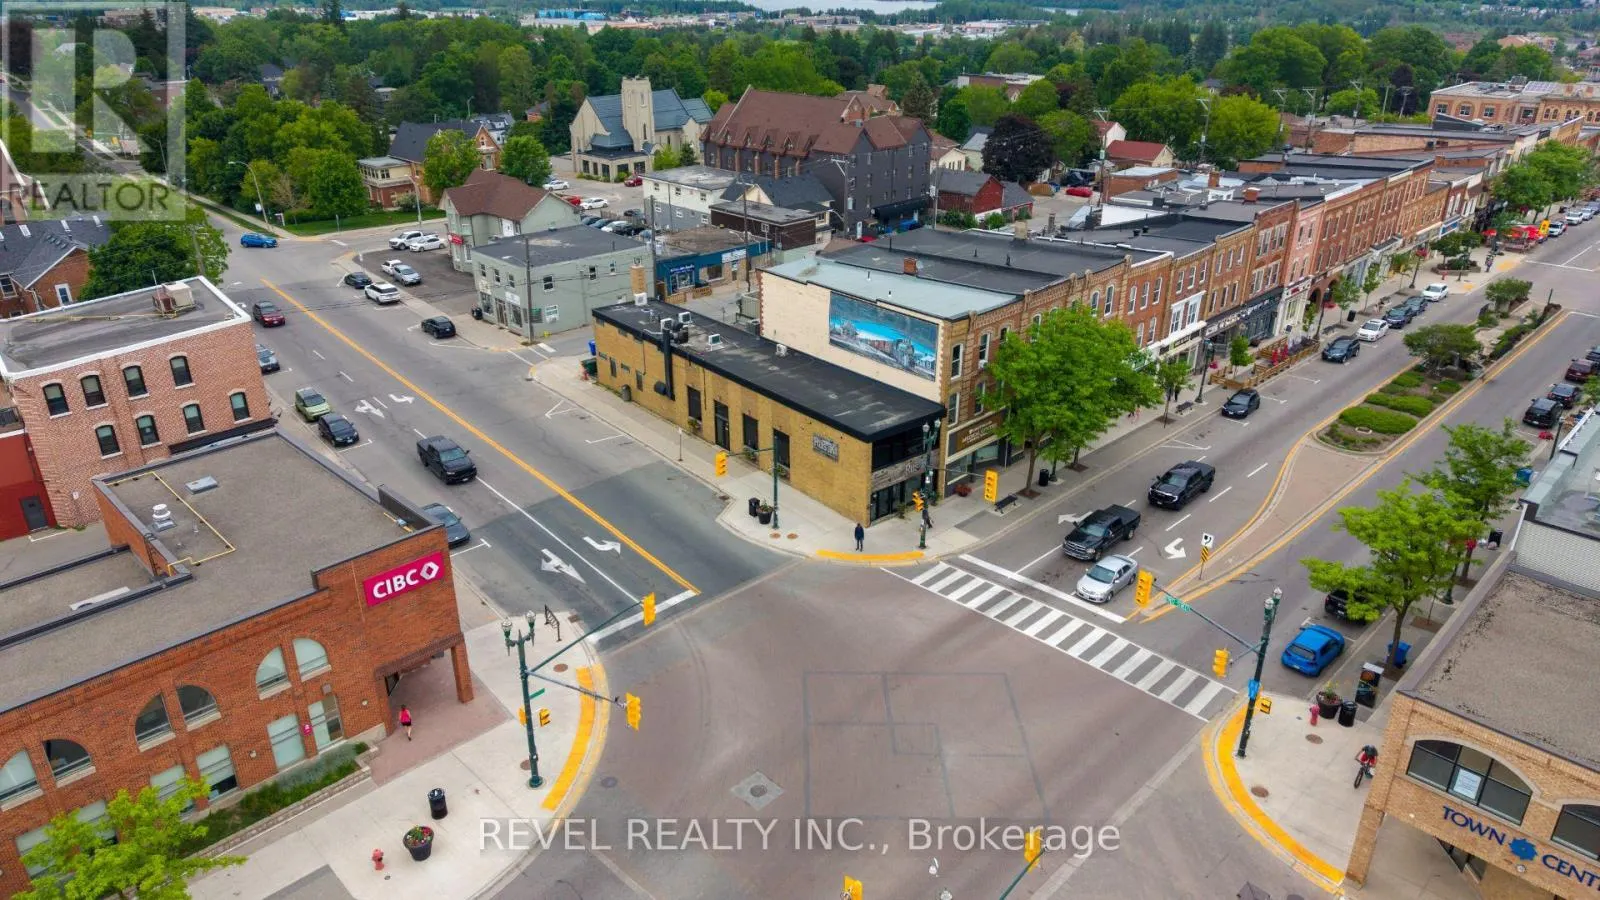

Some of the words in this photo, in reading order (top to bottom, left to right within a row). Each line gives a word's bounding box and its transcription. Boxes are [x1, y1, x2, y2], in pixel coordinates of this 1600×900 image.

[372, 568, 420, 598] CIBC
[1442, 805, 1506, 846] TOWN
[1541, 854, 1600, 892] CENT
